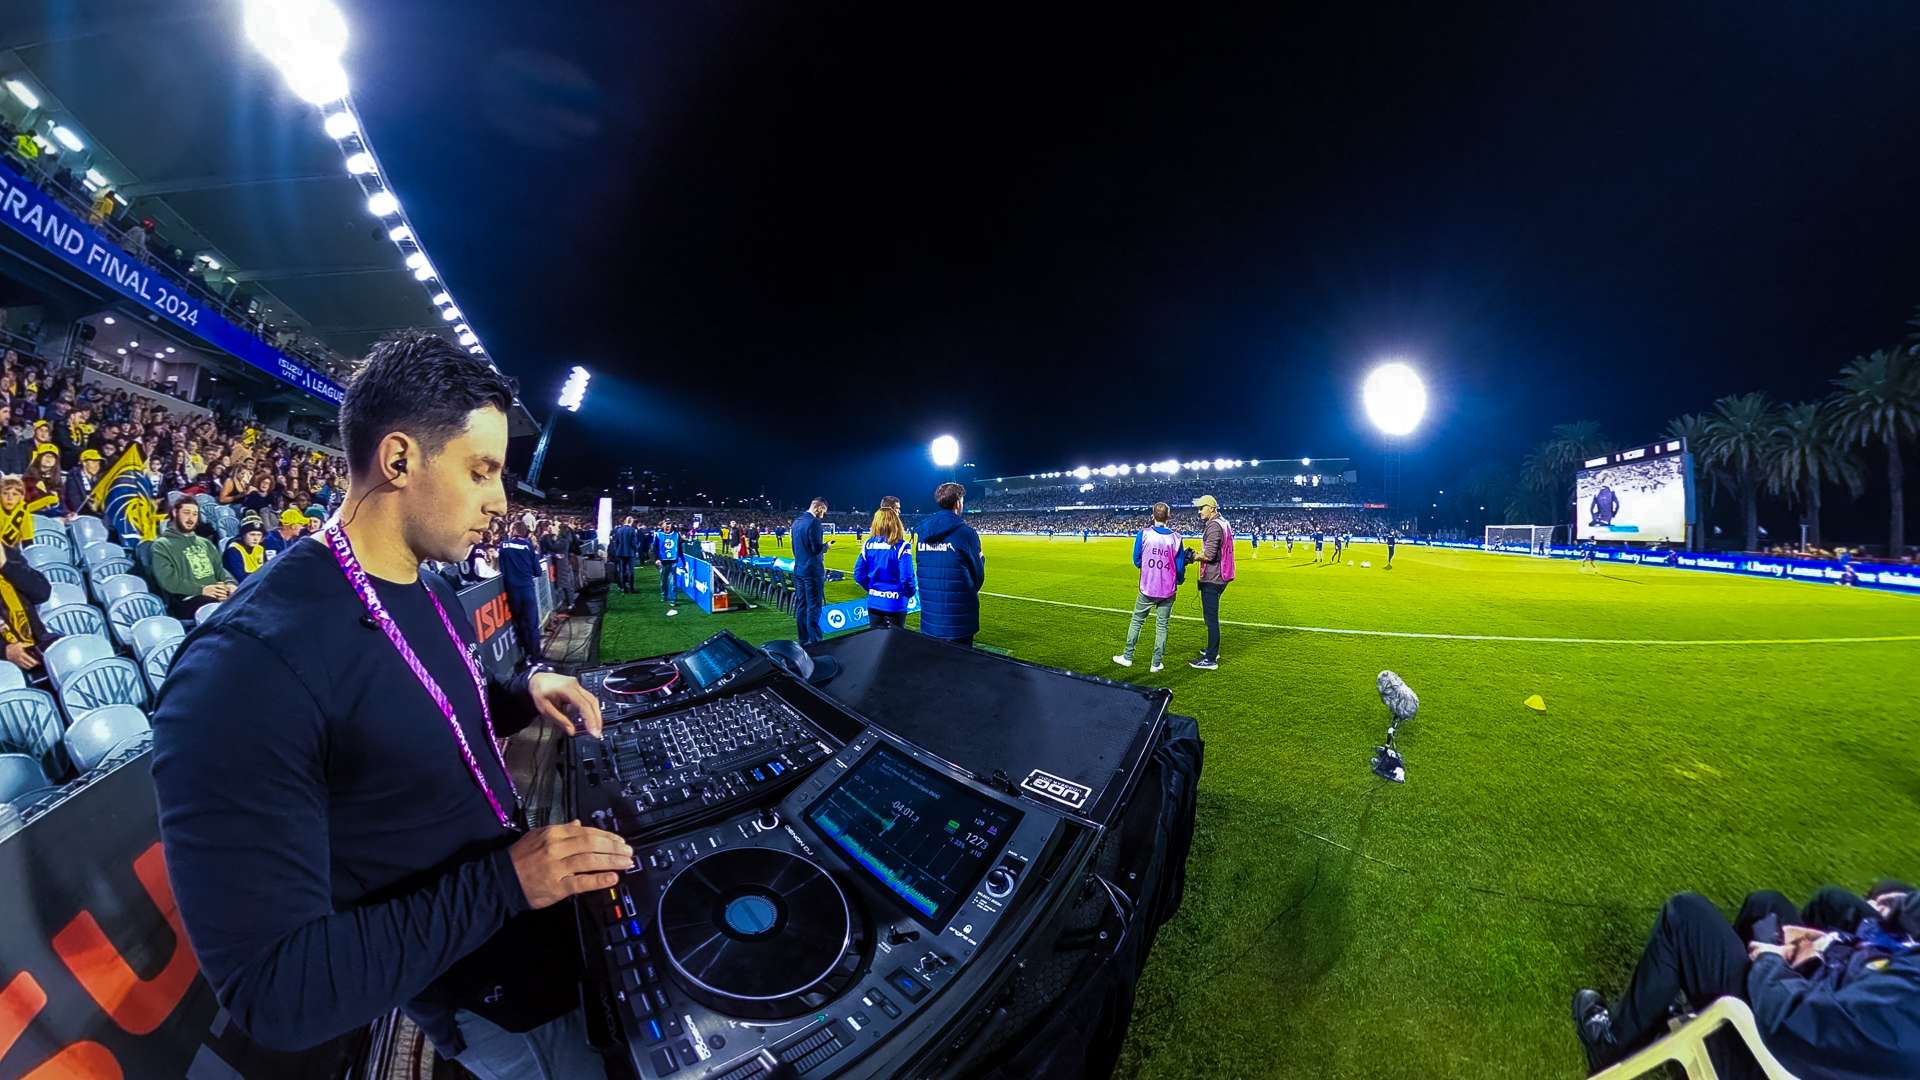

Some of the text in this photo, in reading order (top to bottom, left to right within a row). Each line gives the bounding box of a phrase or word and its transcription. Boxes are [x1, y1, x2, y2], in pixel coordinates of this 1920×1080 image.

[87, 244, 150, 300] FINAL
[154, 287, 199, 326] 2024
[312, 378, 345, 403] LEAGUE
[1152, 548, 1169, 557] ENG
[1148, 558, 1171, 571] 004
[1033, 778, 1080, 801] UDG
